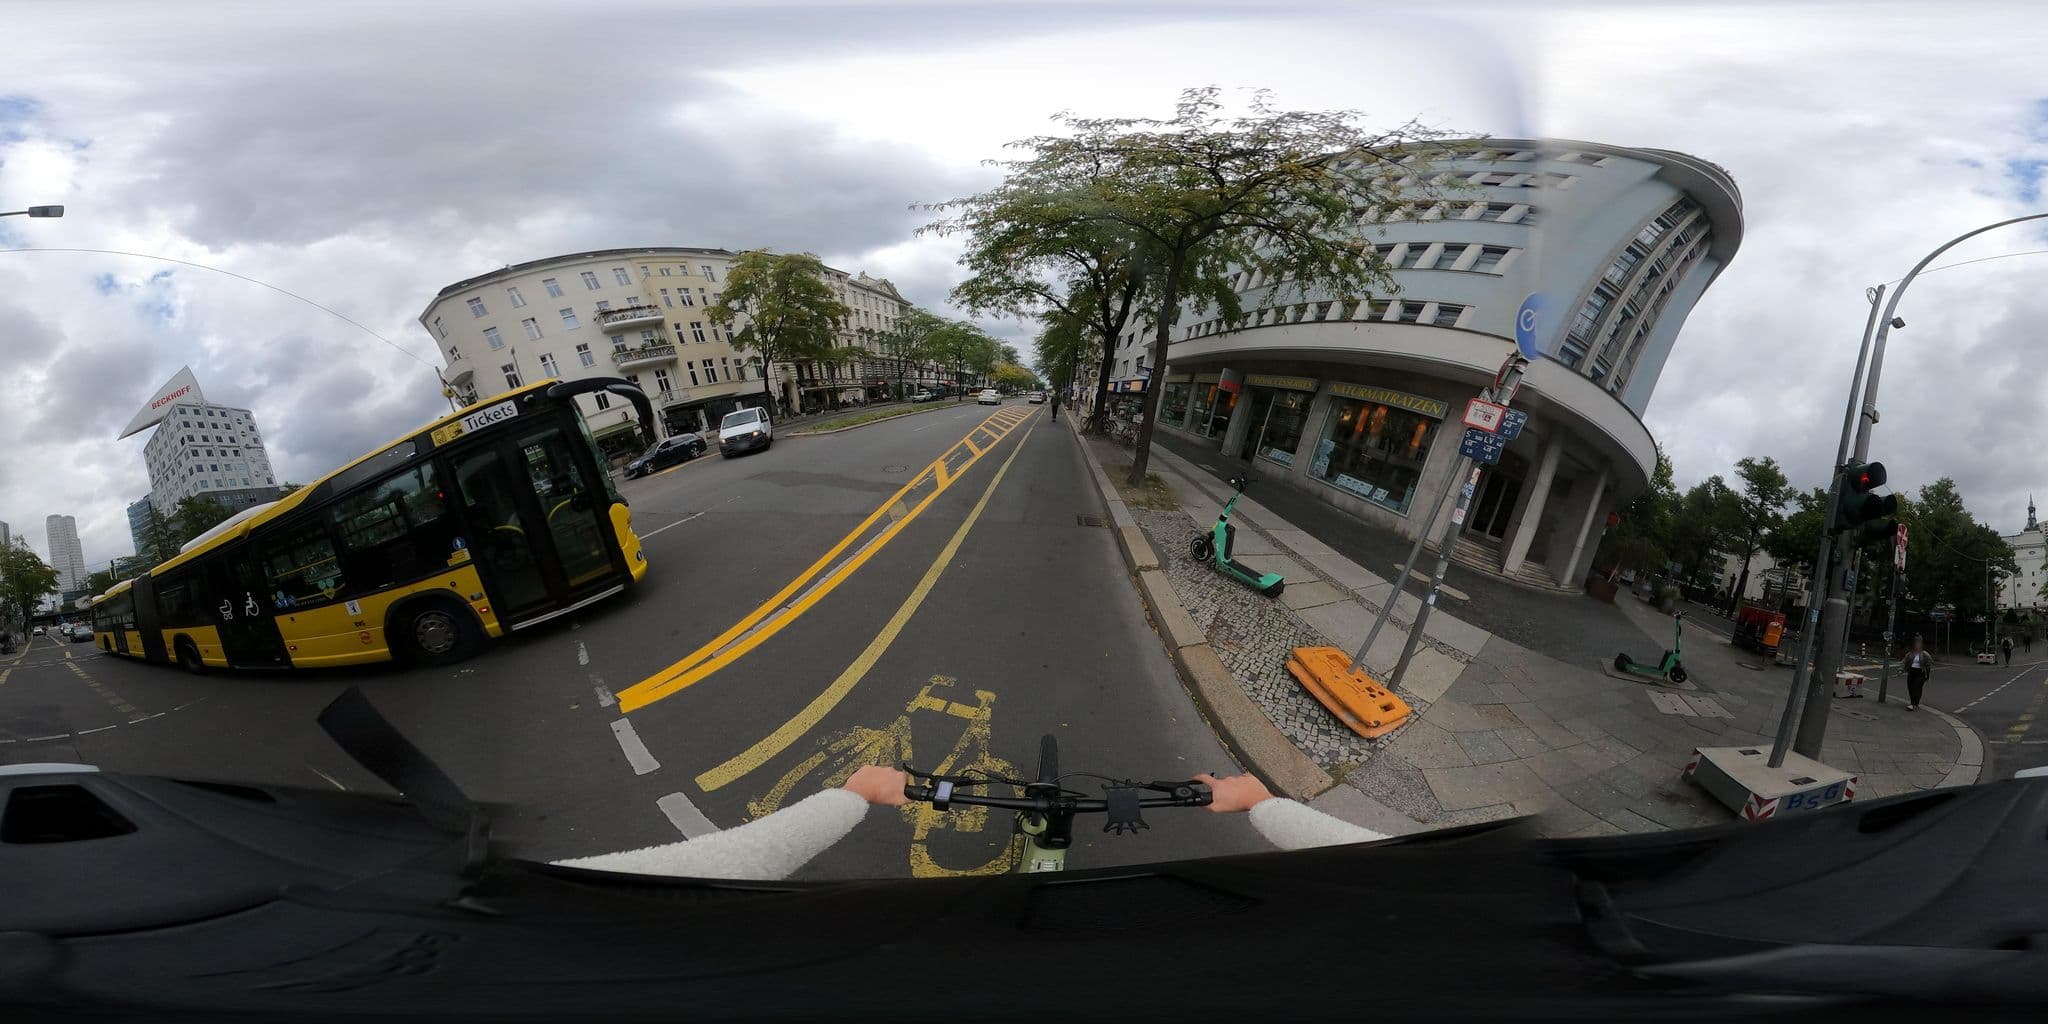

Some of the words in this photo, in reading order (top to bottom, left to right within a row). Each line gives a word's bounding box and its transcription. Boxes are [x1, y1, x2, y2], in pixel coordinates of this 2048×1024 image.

[151, 384, 192, 410] BECKHOFF
[1329, 383, 1441, 415] NATURMATRATZEN
[464, 404, 514, 430] Tickets
[1784, 783, 1841, 810] BSG
